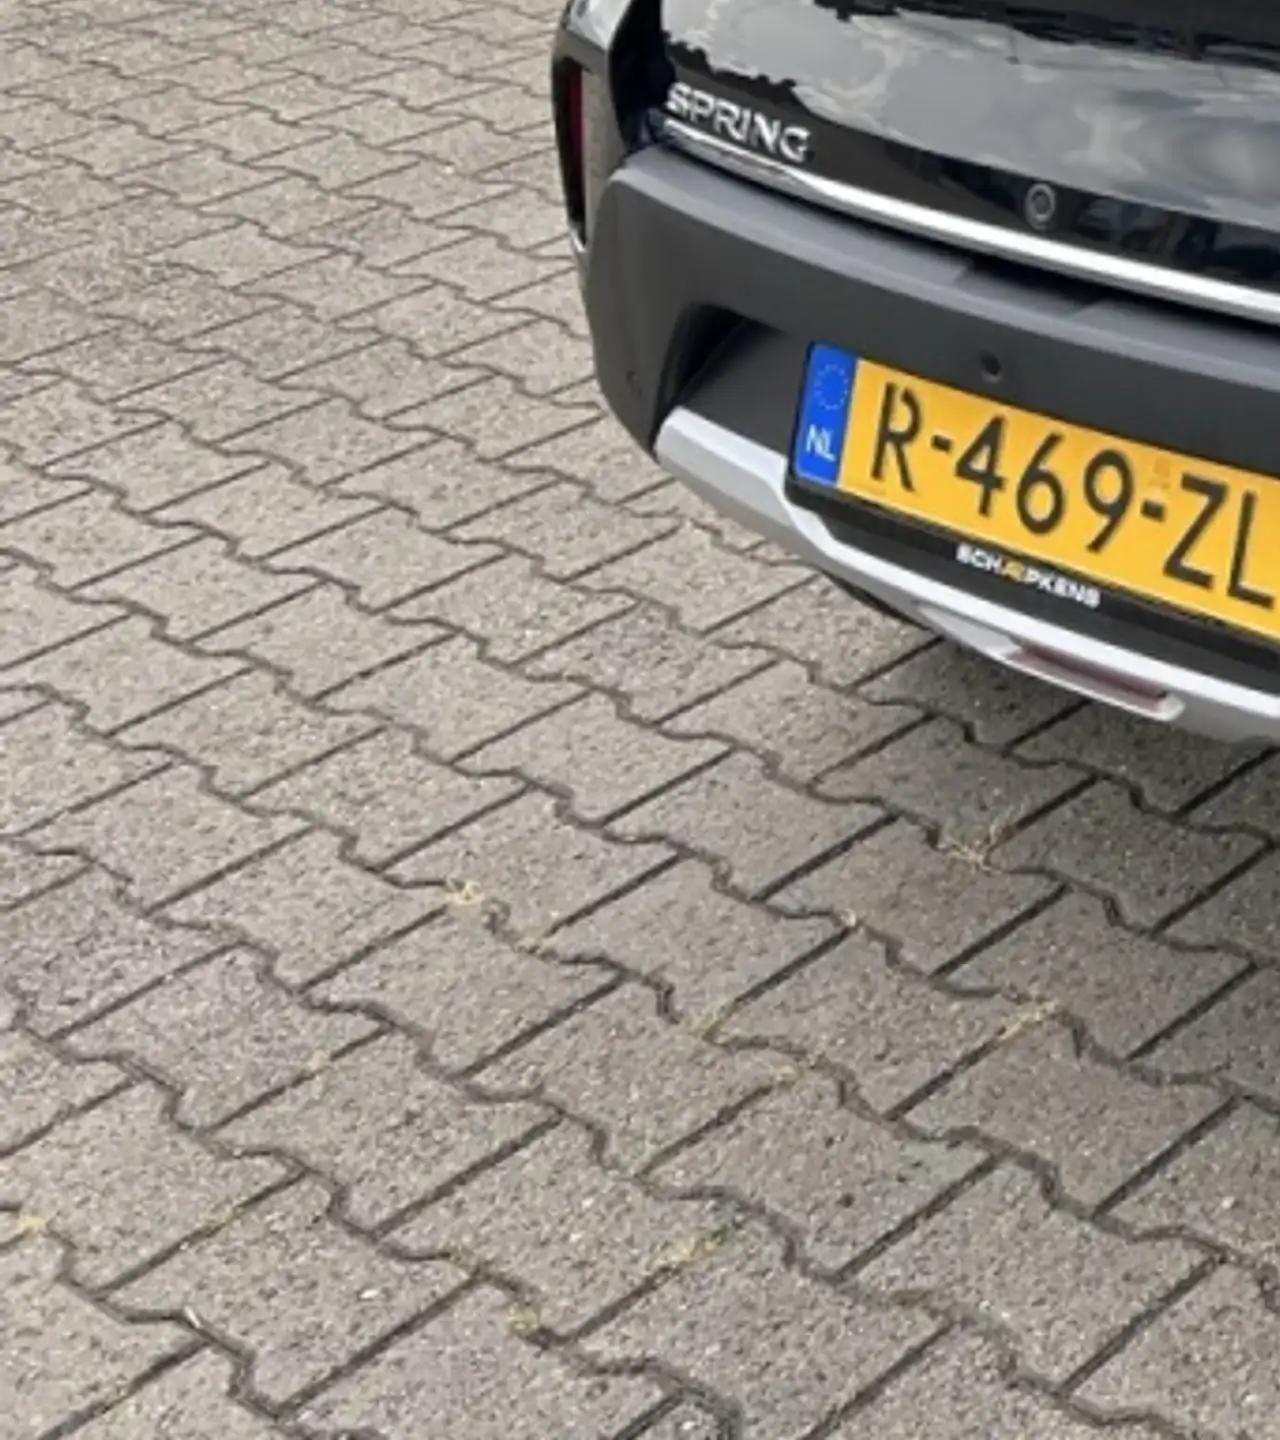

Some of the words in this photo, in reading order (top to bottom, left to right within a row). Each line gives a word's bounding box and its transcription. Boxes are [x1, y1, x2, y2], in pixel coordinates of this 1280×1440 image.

[666, 81, 811, 164] SPRING
[805, 422, 836, 461] NL
[869, 380, 1276, 611] R-469-ZL
